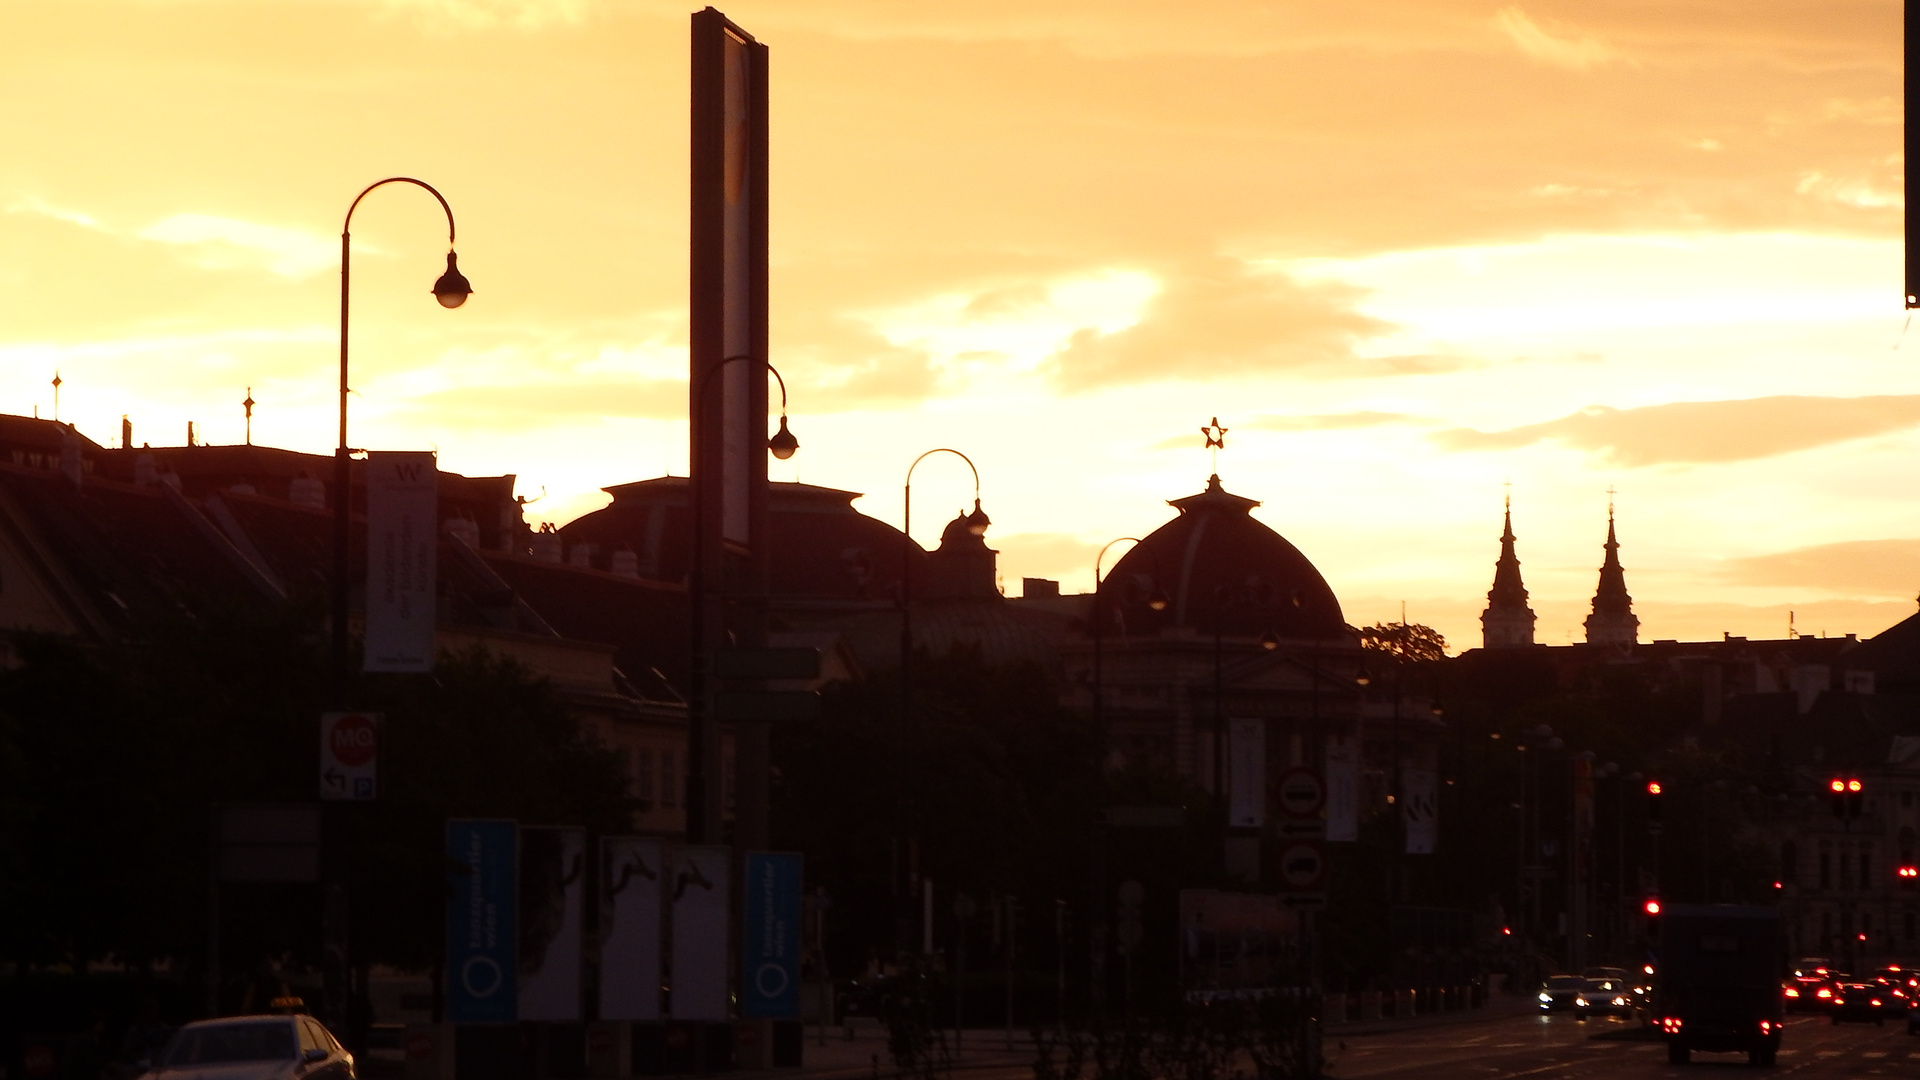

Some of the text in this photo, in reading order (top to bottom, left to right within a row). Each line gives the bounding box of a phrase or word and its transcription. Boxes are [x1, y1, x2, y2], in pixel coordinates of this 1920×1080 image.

[334, 726, 375, 748] MQ
[357, 779, 370, 795] P
[467, 829, 485, 948] tanzquartier
[761, 861, 777, 957] tanzquartier
[482, 903, 497, 948] wien
[774, 920, 787, 957] wien
